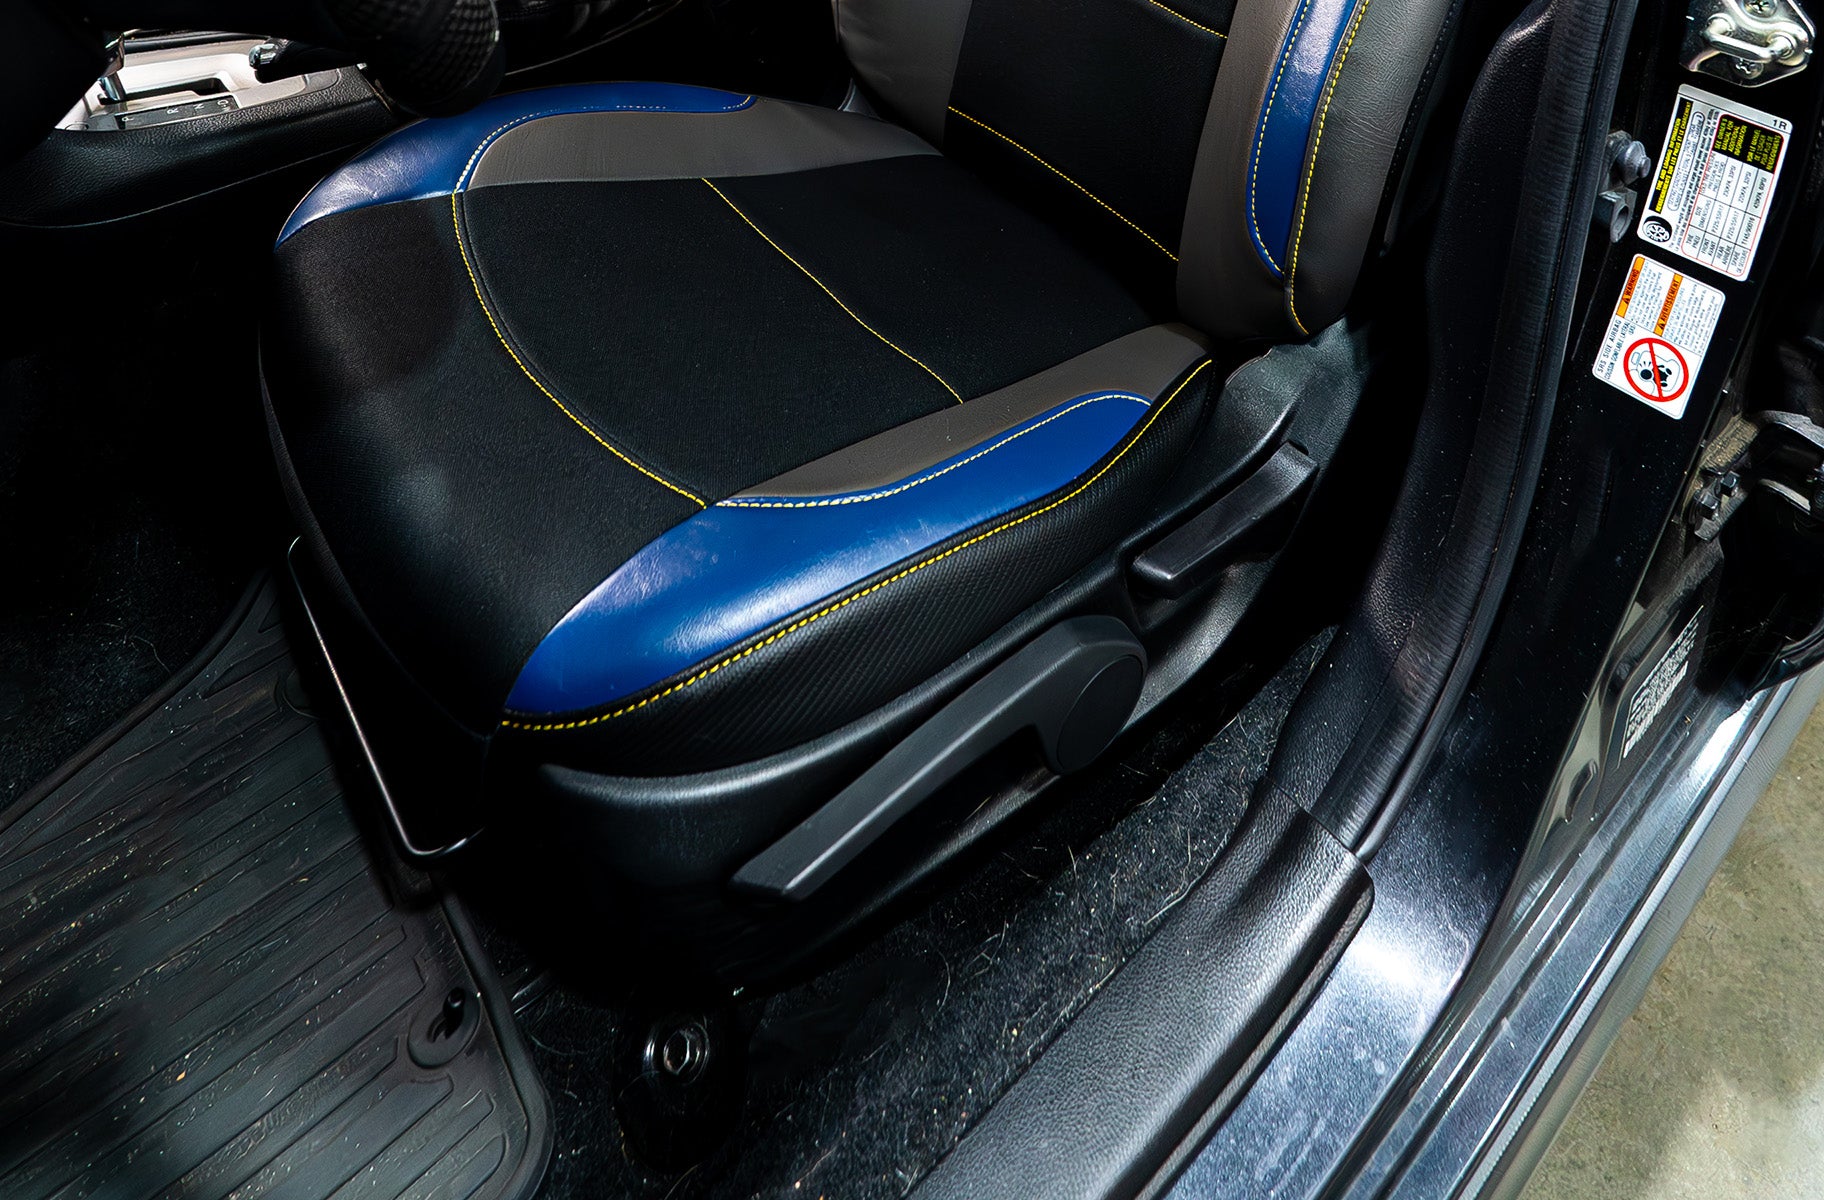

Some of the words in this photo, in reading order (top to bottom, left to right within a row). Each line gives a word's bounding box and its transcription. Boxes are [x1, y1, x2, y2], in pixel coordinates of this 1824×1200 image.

[1607, 317, 1622, 343] AIRBAG
[1601, 343, 1613, 359] SIDE
[1596, 358, 1607, 374] SRS
